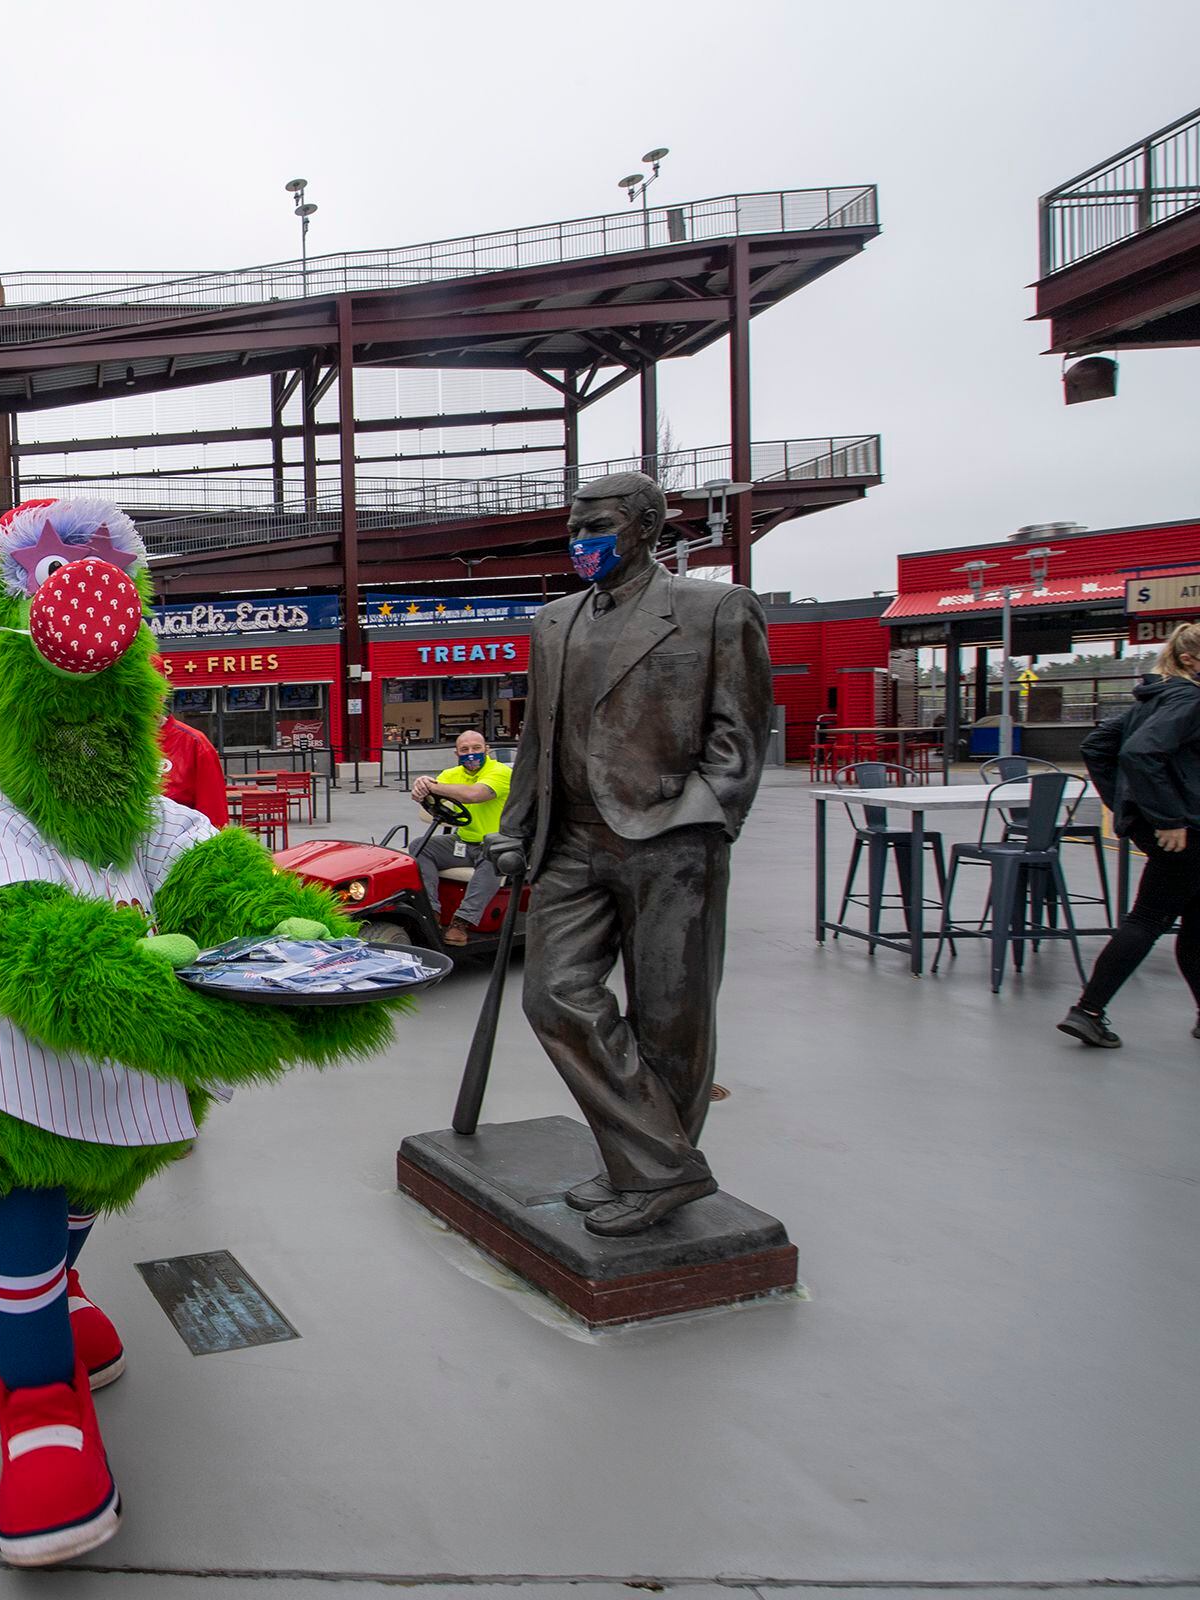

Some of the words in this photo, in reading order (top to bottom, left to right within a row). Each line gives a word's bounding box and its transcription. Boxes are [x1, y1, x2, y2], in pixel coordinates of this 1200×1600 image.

[1181, 585, 1200, 597] AT
[236, 602, 309, 631] Eats
[417, 643, 516, 663] TREATS
[207, 654, 279, 673] FRIES
